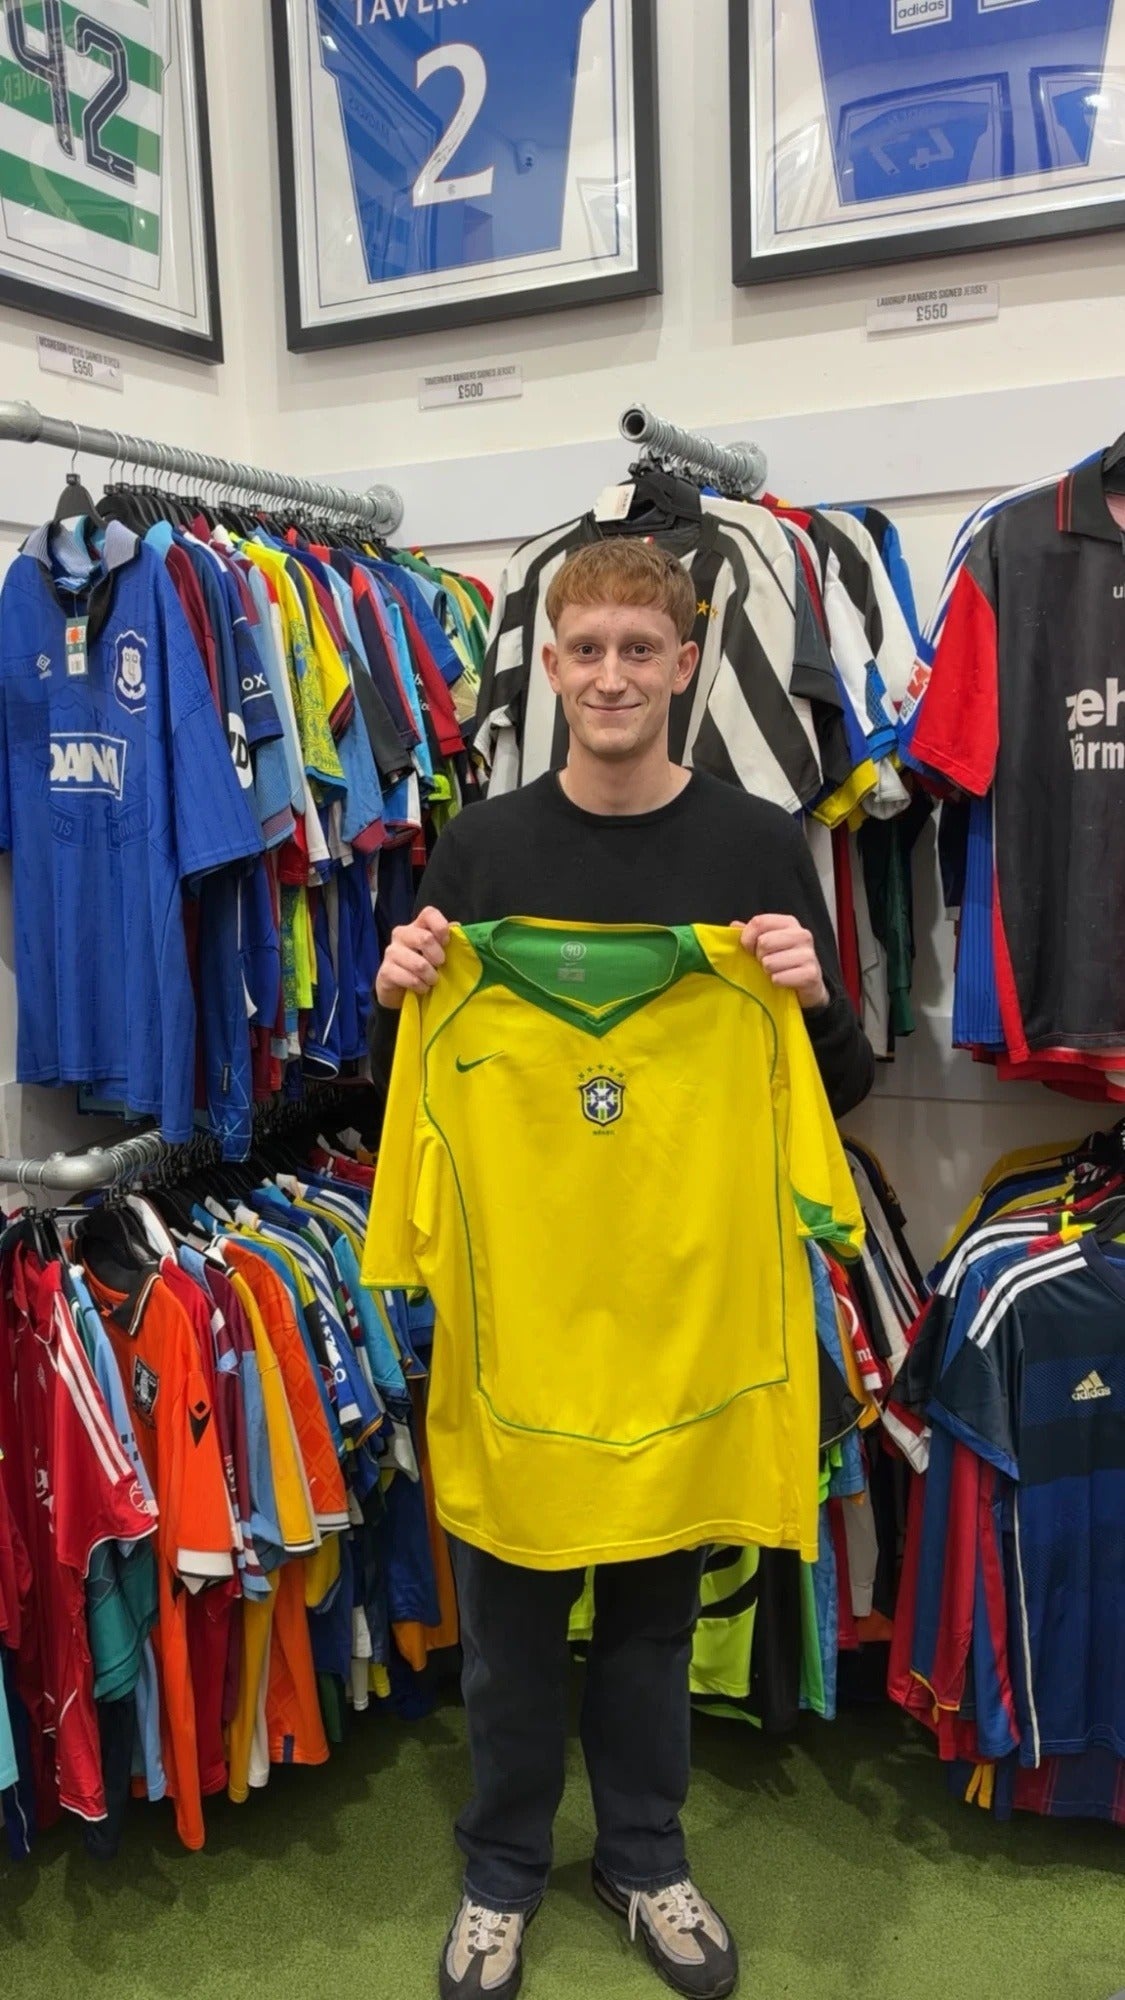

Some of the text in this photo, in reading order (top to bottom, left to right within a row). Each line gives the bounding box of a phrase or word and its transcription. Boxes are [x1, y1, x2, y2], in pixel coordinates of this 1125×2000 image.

[897, 0, 945, 19] adidas
[3, 0, 138, 189] 42
[412, 42, 494, 208] 2
[877, 283, 988, 307] LAUDRUP RANGERS SIGNED JERSEY
[916, 302, 948, 322] £550
[477, 368, 496, 379] SIGNED
[496, 365, 516, 377] JERSEY
[457, 382, 484, 399] £500
[1071, 1386, 1111, 1401] adidas
